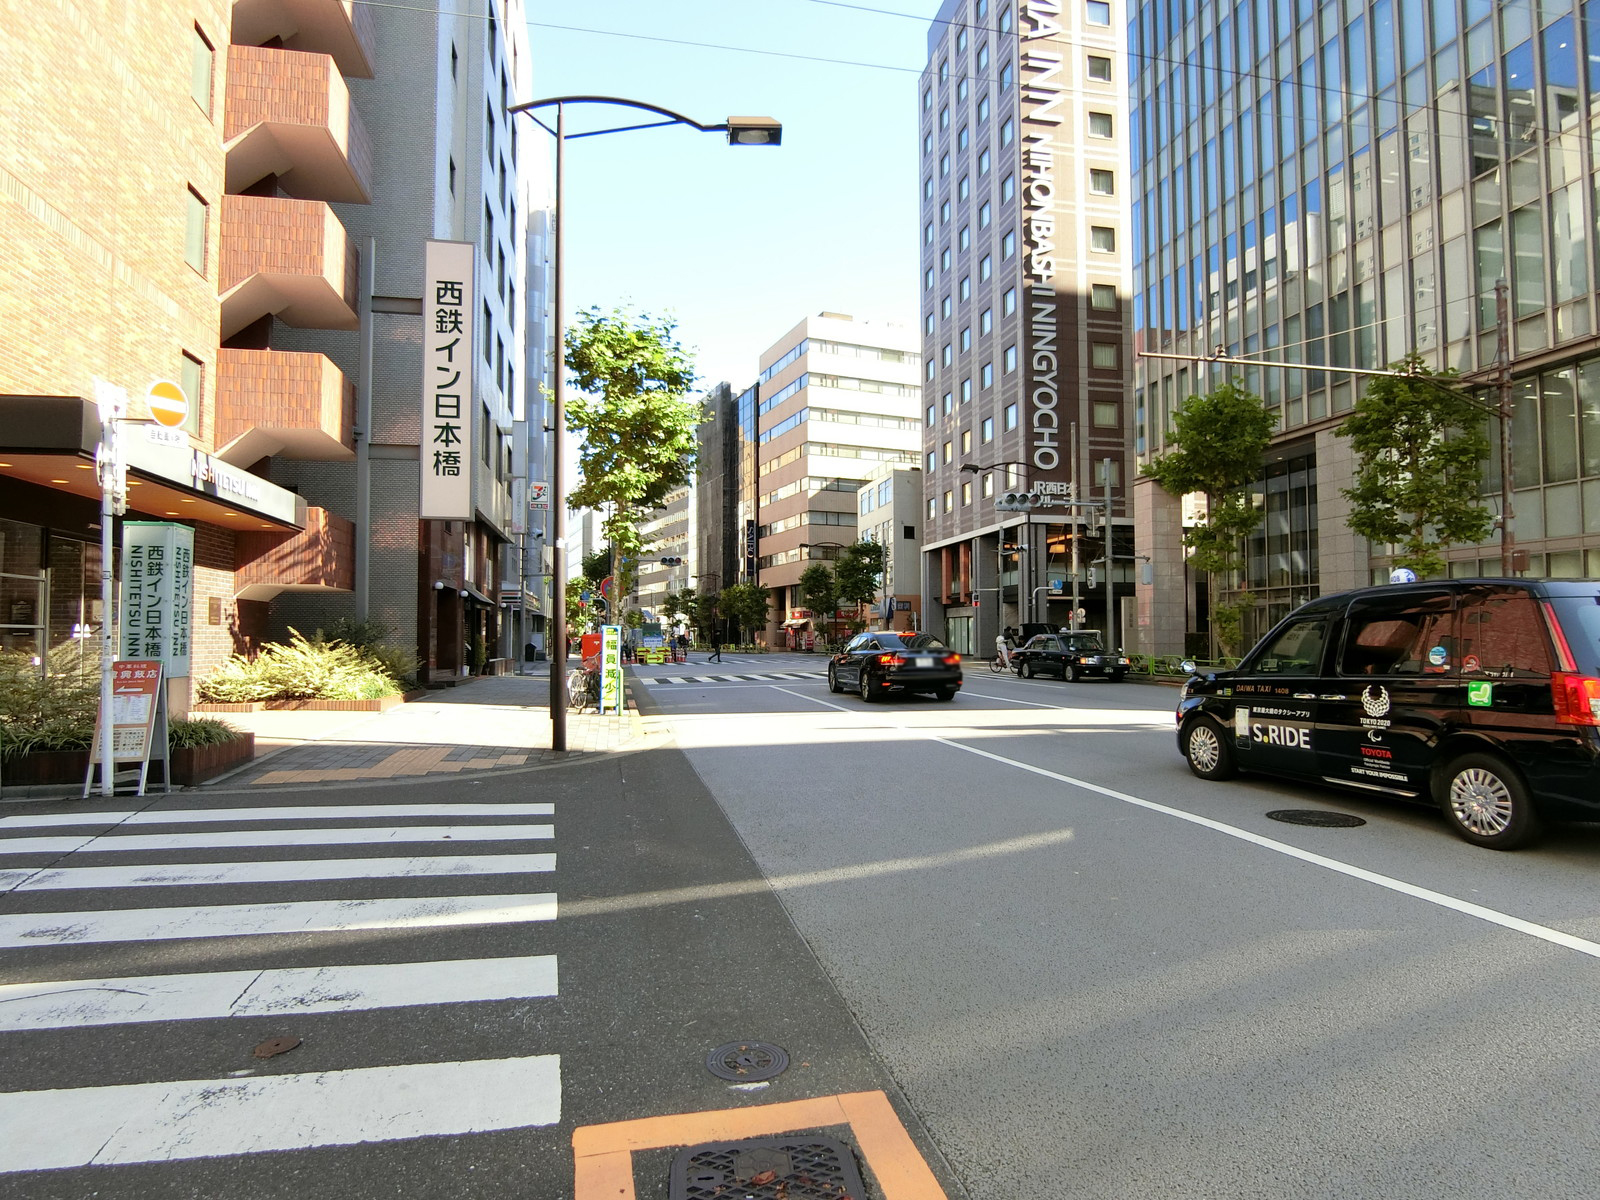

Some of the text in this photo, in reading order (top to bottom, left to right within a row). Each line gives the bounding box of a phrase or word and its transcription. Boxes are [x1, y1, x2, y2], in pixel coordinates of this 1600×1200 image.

[1028, 50, 1065, 124] INN
[1029, 132, 1056, 297] NIHONBASHI
[433, 280, 463, 477] 西鉄イン日本橋
[1032, 303, 1058, 471] NINGYOCHO
[191, 458, 245, 497] NISHITETSU
[127, 545, 143, 657] NISHITETSU INN
[144, 545, 165, 657] 西鉄イン日本橋
[173, 546, 182, 628] NISHITETSU
[180, 548, 191, 657] 西鉄イン日本橋
[604, 639, 617, 694] 幅員減少
[1236, 684, 1255, 692] DAIWA
[1252, 723, 1311, 749] S.RIDE
[1360, 747, 1392, 759] TOYOTA
